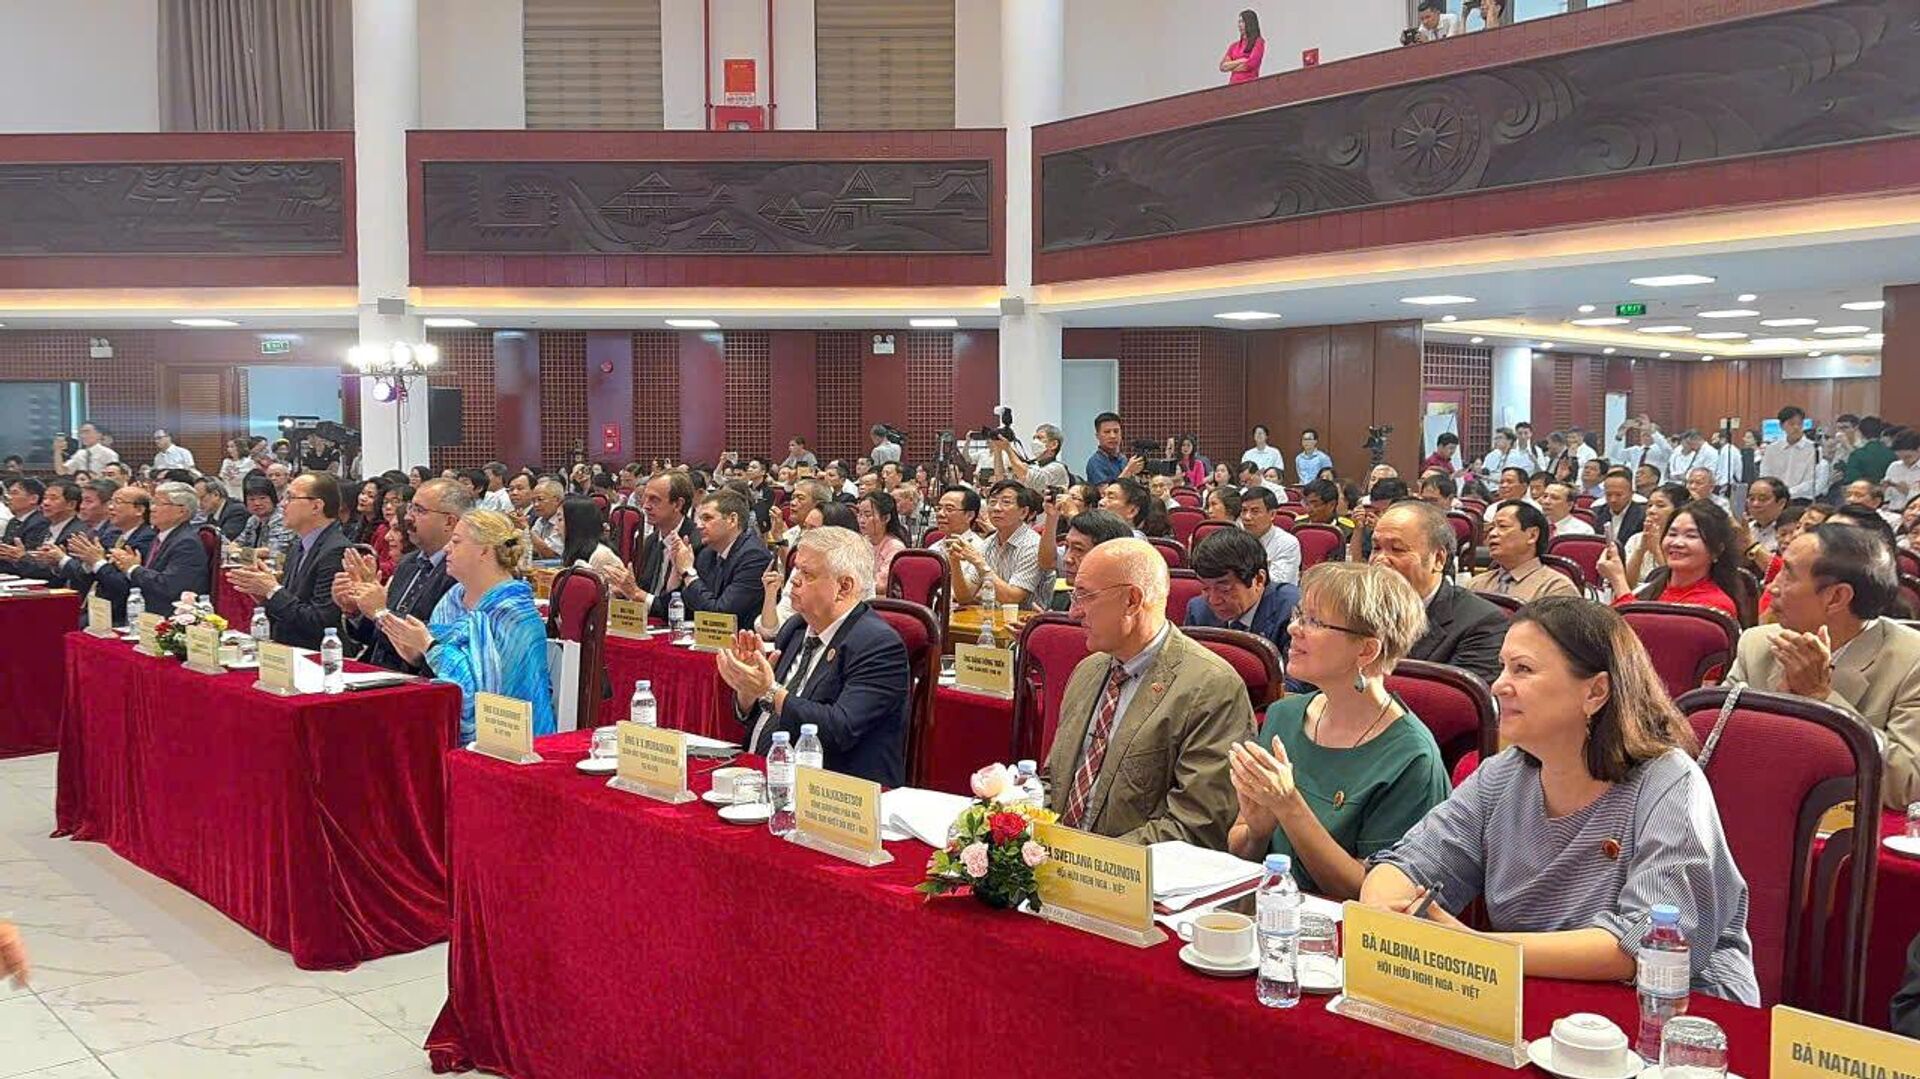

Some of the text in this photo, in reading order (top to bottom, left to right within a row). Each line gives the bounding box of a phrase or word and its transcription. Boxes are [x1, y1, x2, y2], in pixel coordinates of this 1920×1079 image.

[1054, 847, 1092, 870] SVETLANA
[1094, 858, 1141, 883] GLAZUNOVA
[1362, 932, 1498, 985] BÀ ALBINA LEGOSTAEVA
[1376, 960, 1391, 975] HỘI
[1393, 963, 1411, 980] HỮU
[1412, 969, 1434, 989] NGHỊ
[1435, 976, 1453, 992] NGA
[1461, 984, 1480, 1001] VIỆT
[1792, 1041, 1885, 1079] BÀ NATALIA
